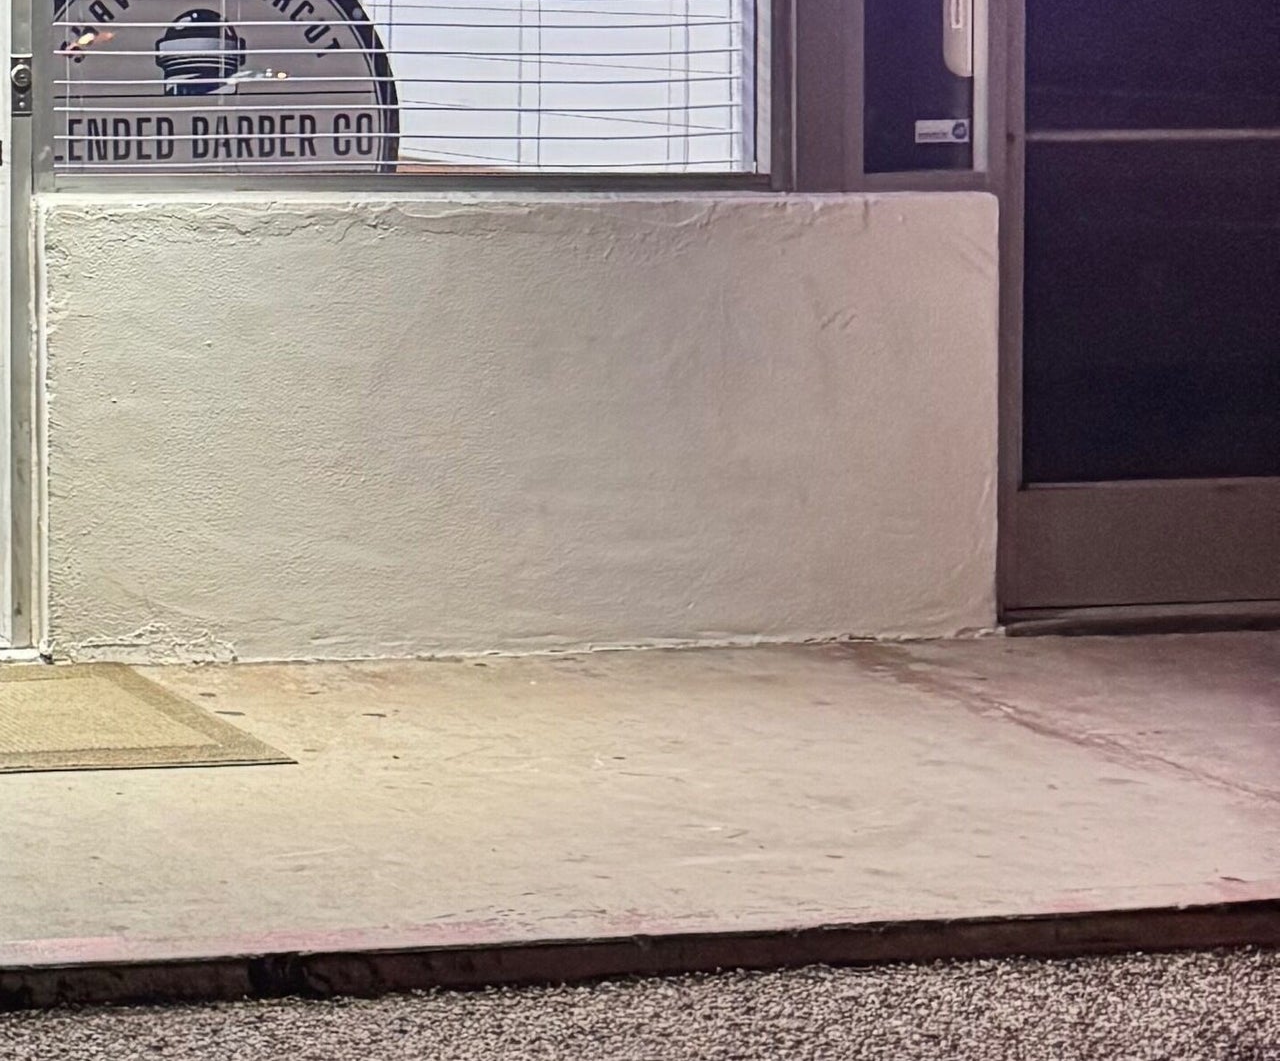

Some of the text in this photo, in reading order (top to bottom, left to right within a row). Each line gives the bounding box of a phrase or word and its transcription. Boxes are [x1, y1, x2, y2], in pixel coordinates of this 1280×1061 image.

[54, 112, 374, 162] ENDED BARBER CO
